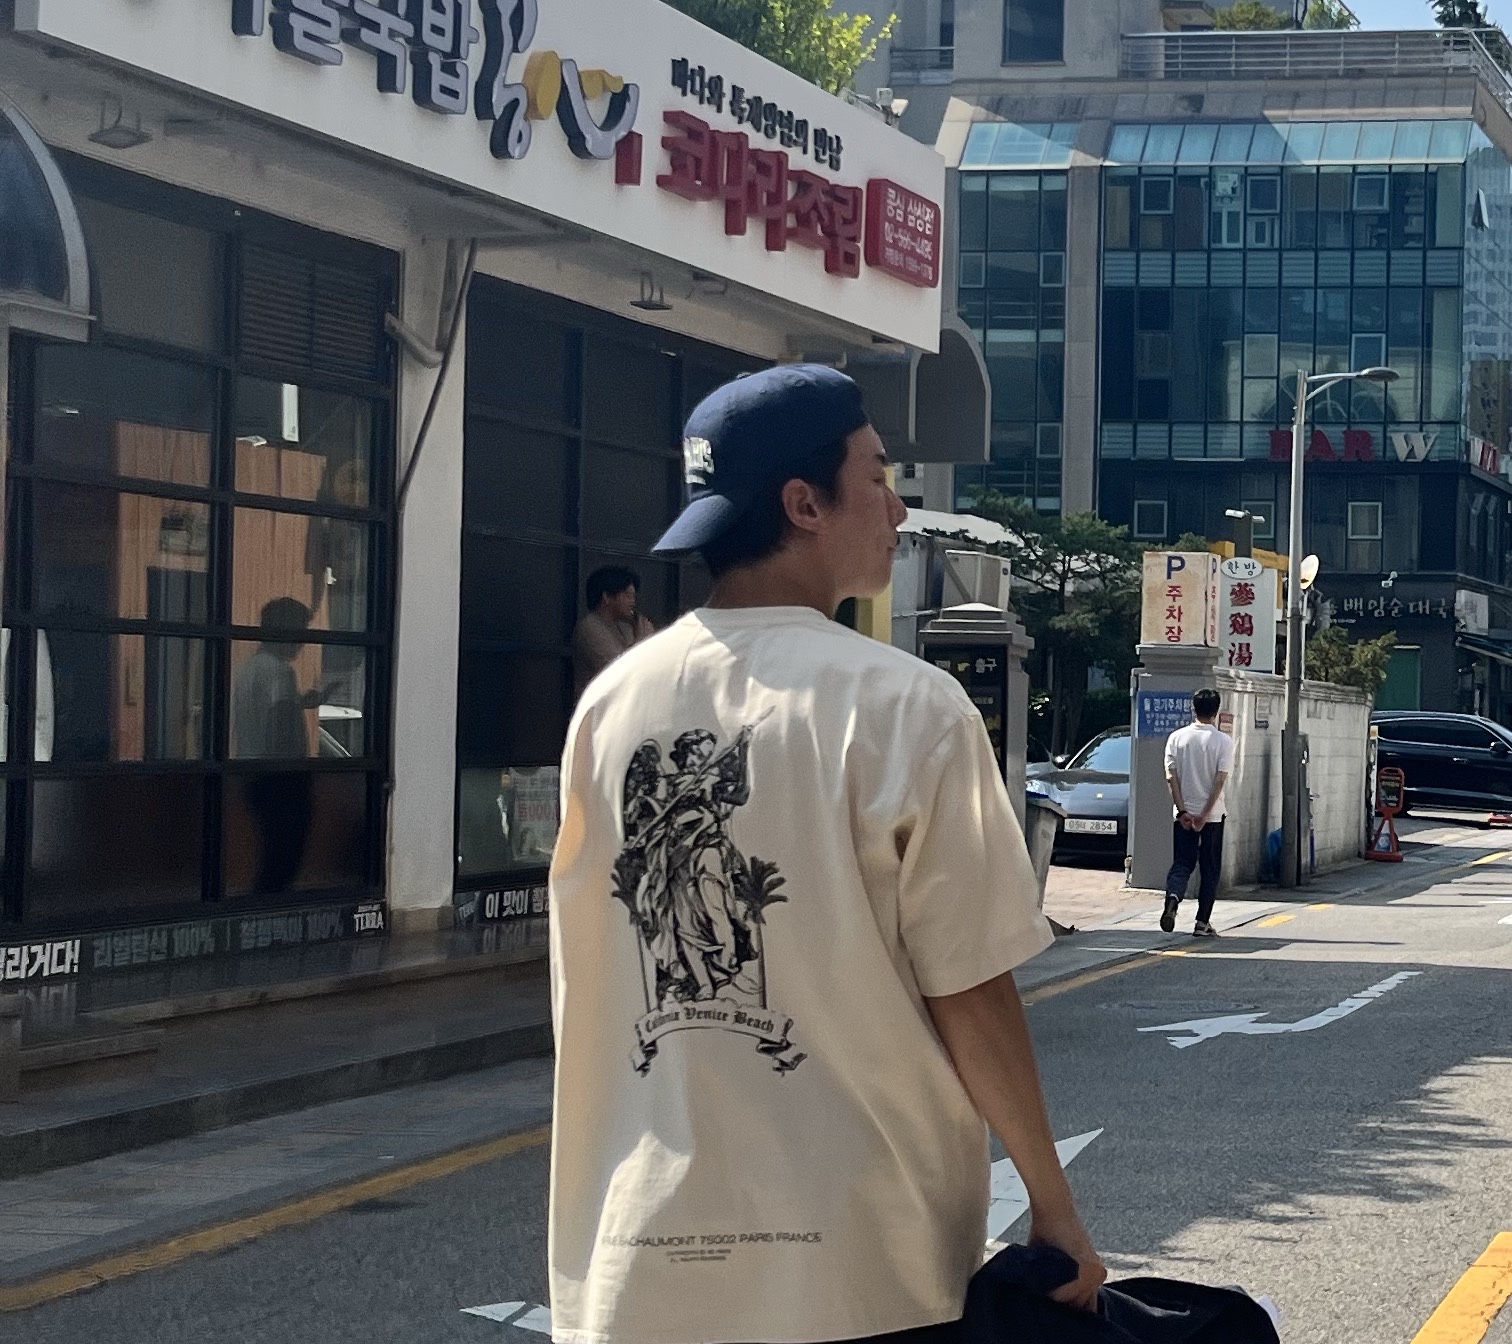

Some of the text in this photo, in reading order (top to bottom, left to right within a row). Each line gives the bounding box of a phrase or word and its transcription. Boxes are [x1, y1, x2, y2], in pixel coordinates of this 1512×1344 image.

[656, 110, 864, 280] 코다리조림
[1269, 429, 1375, 463] BAR
[1390, 432, 1440, 463] W
[1166, 556, 1186, 580] P
[1227, 561, 1257, 576] 한방
[1165, 585, 1183, 643] 주차장
[0, 939, 81, 981] 라거다!
[683, 1007, 729, 1022] Venice
[733, 1010, 775, 1033] Beach
